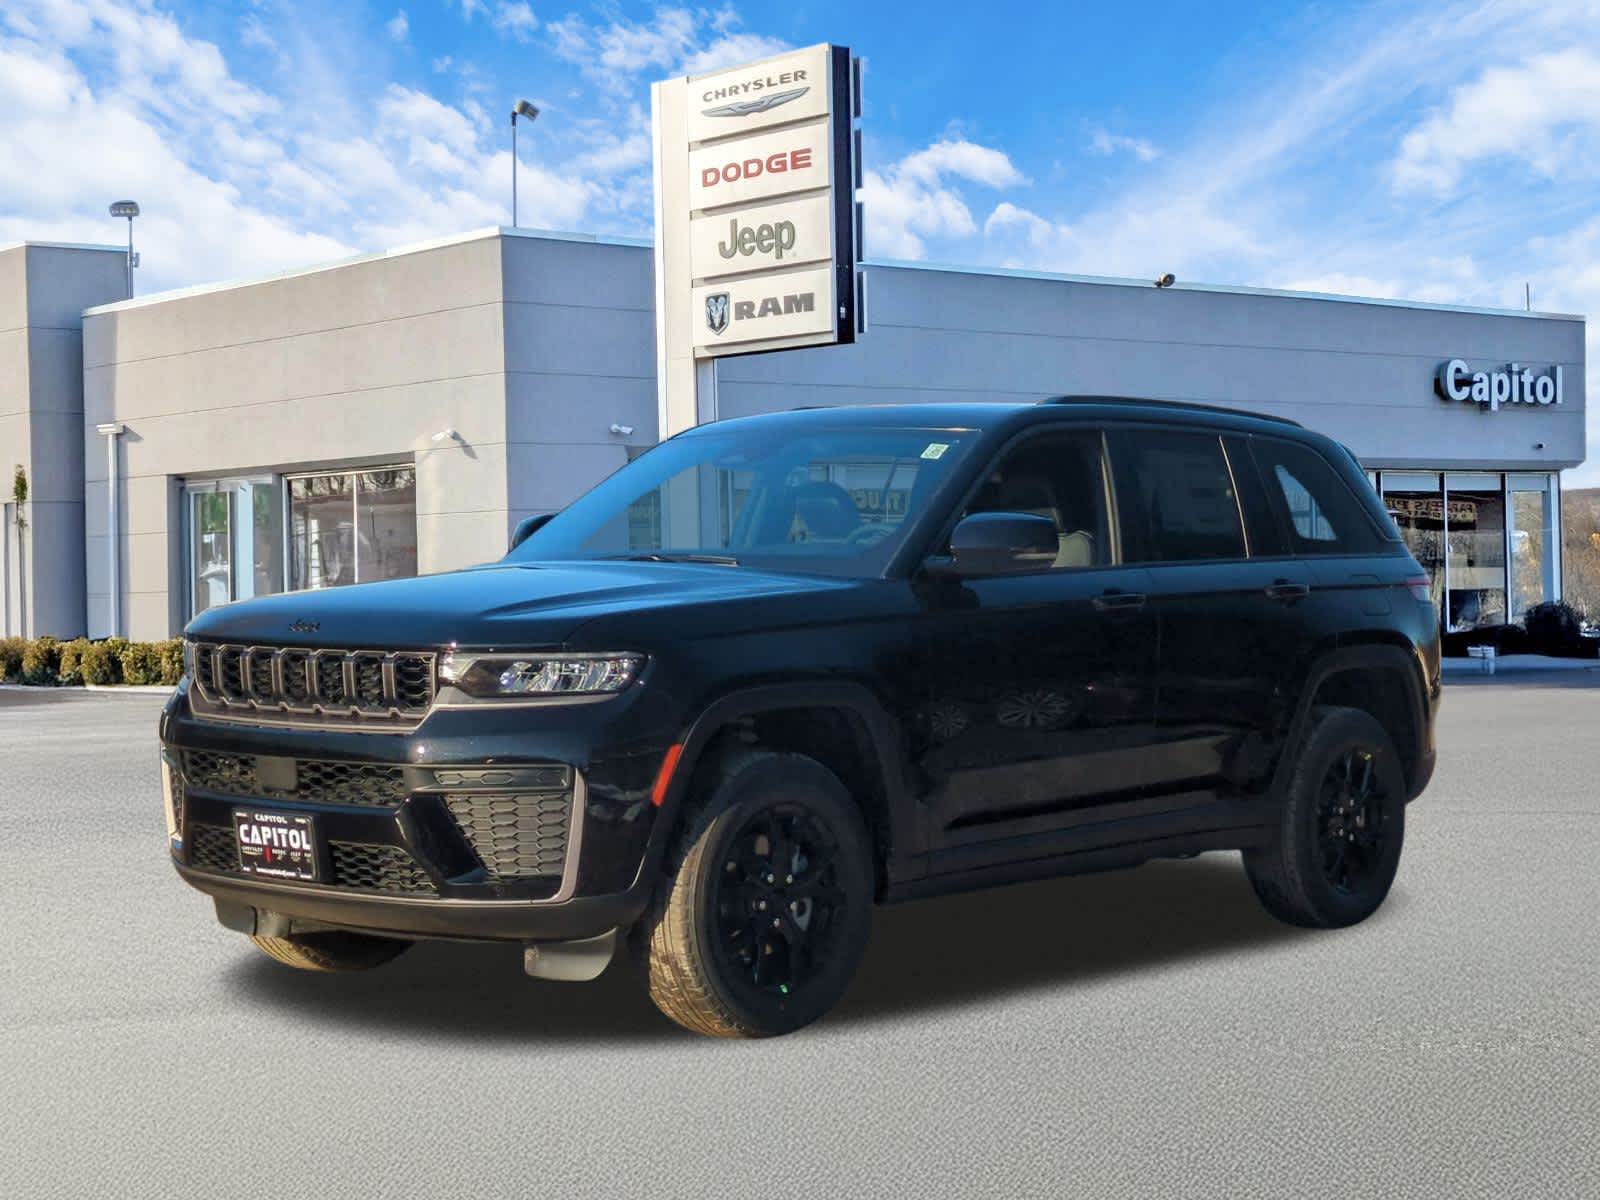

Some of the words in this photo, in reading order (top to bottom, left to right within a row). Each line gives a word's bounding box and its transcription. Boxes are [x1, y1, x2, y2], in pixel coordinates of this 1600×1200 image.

[703, 70, 807, 102] CHRYSLER
[702, 148, 812, 187] DODGE
[718, 219, 796, 259] Jeep
[734, 292, 815, 321] RAM
[1446, 358, 1563, 412] Capitol
[254, 813, 288, 824] CAPITOL
[239, 823, 311, 851] CAPITOL
